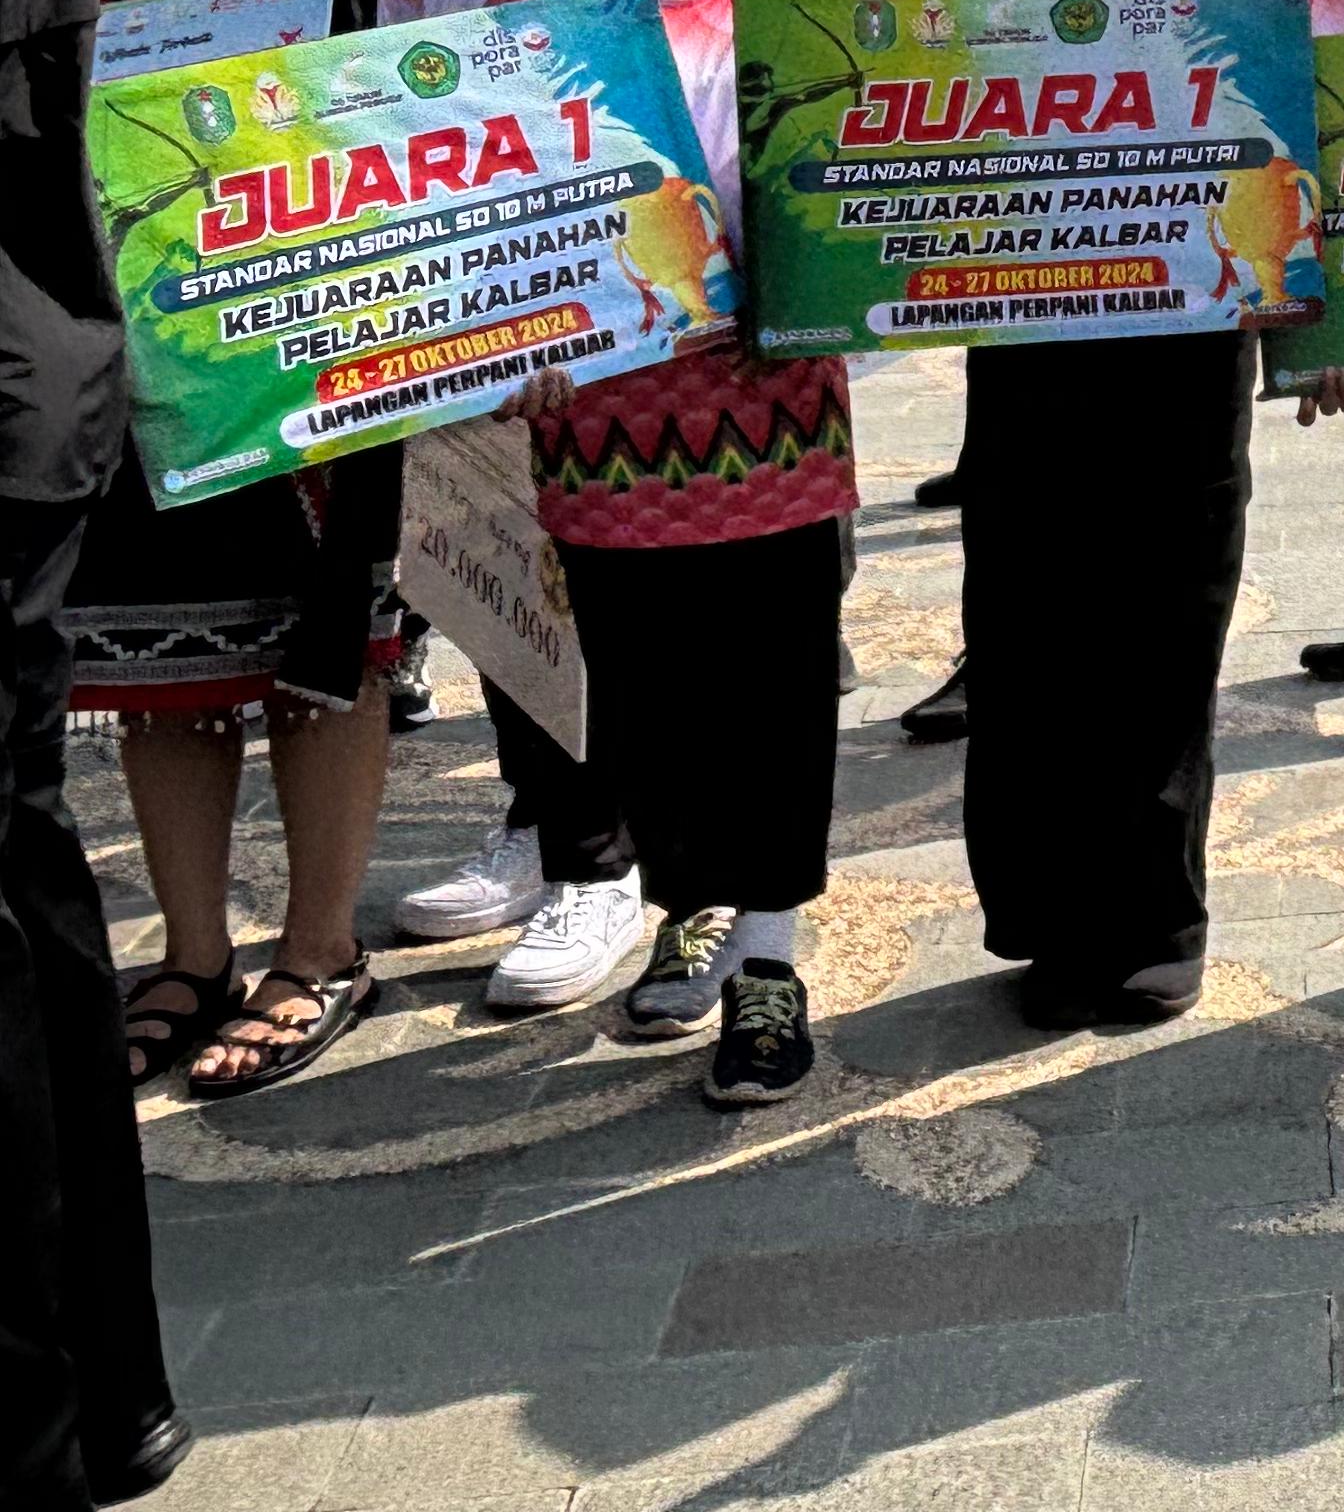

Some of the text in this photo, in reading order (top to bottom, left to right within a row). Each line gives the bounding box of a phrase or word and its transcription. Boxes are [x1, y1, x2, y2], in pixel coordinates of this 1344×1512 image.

[1120, 7, 1166, 25] pora
[1133, 20, 1164, 38] par
[472, 45, 519, 69] pora
[483, 29, 515, 47] dis
[488, 60, 521, 83] par
[840, 66, 1219, 147] JUARA 1
[199, 97, 592, 254] JUARA 1
[824, 161, 939, 182] STANDAR
[947, 152, 1068, 178] NASIONAL
[1146, 149, 1165, 166] M
[1170, 145, 1239, 165] PUTRI
[841, 181, 1228, 226] KEJUARAAN PANAHAN
[181, 251, 313, 300] STANDAR
[319, 215, 450, 267] NASIONAL
[553, 173, 634, 209] PUTRA
[883, 221, 1189, 262] PELAJAR KALBAR
[222, 211, 628, 341] KEJUARAAN PANAHAN
[920, 263, 1154, 296] 24 27 OKTOBER 2024
[282, 259, 599, 366] PELAJAR KALBAR
[892, 301, 1003, 327] LAPANGAN
[330, 310, 579, 396] 24 27 OKTOBER 2024
[308, 382, 428, 435] LAPANGAN
[434, 355, 526, 397] PERPANI
